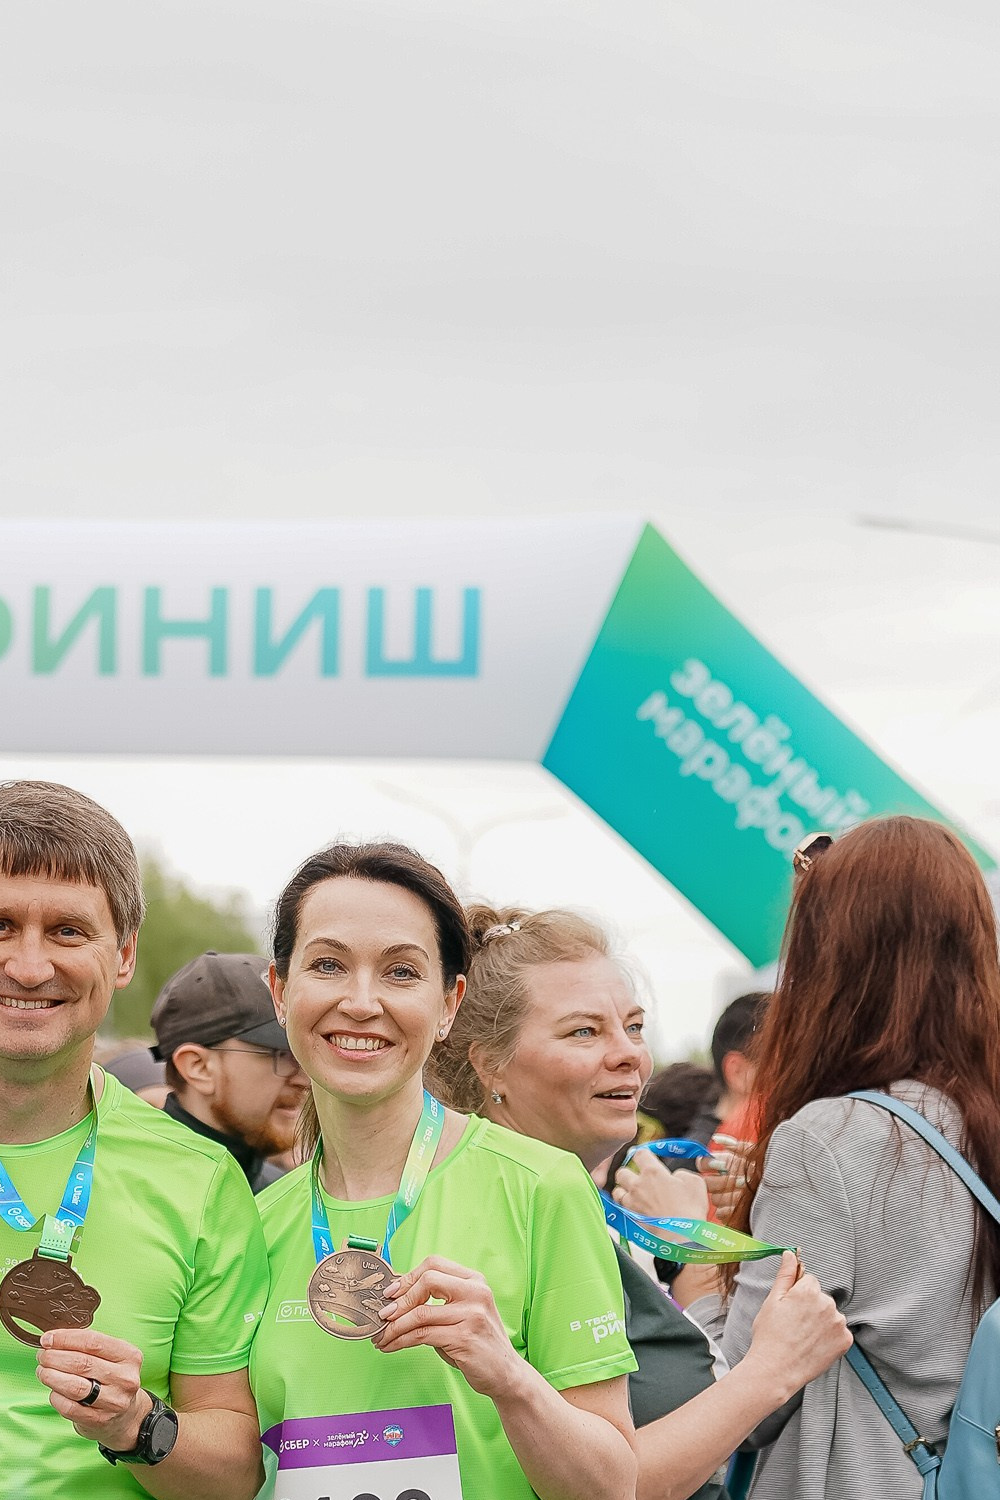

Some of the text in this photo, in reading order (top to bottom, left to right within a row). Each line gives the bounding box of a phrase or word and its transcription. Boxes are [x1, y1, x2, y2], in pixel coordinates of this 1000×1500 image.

[635, 690, 806, 858] марафо
[701, 1229, 718, 1241] 185
[284, 1438, 310, 1450] СБЕР
